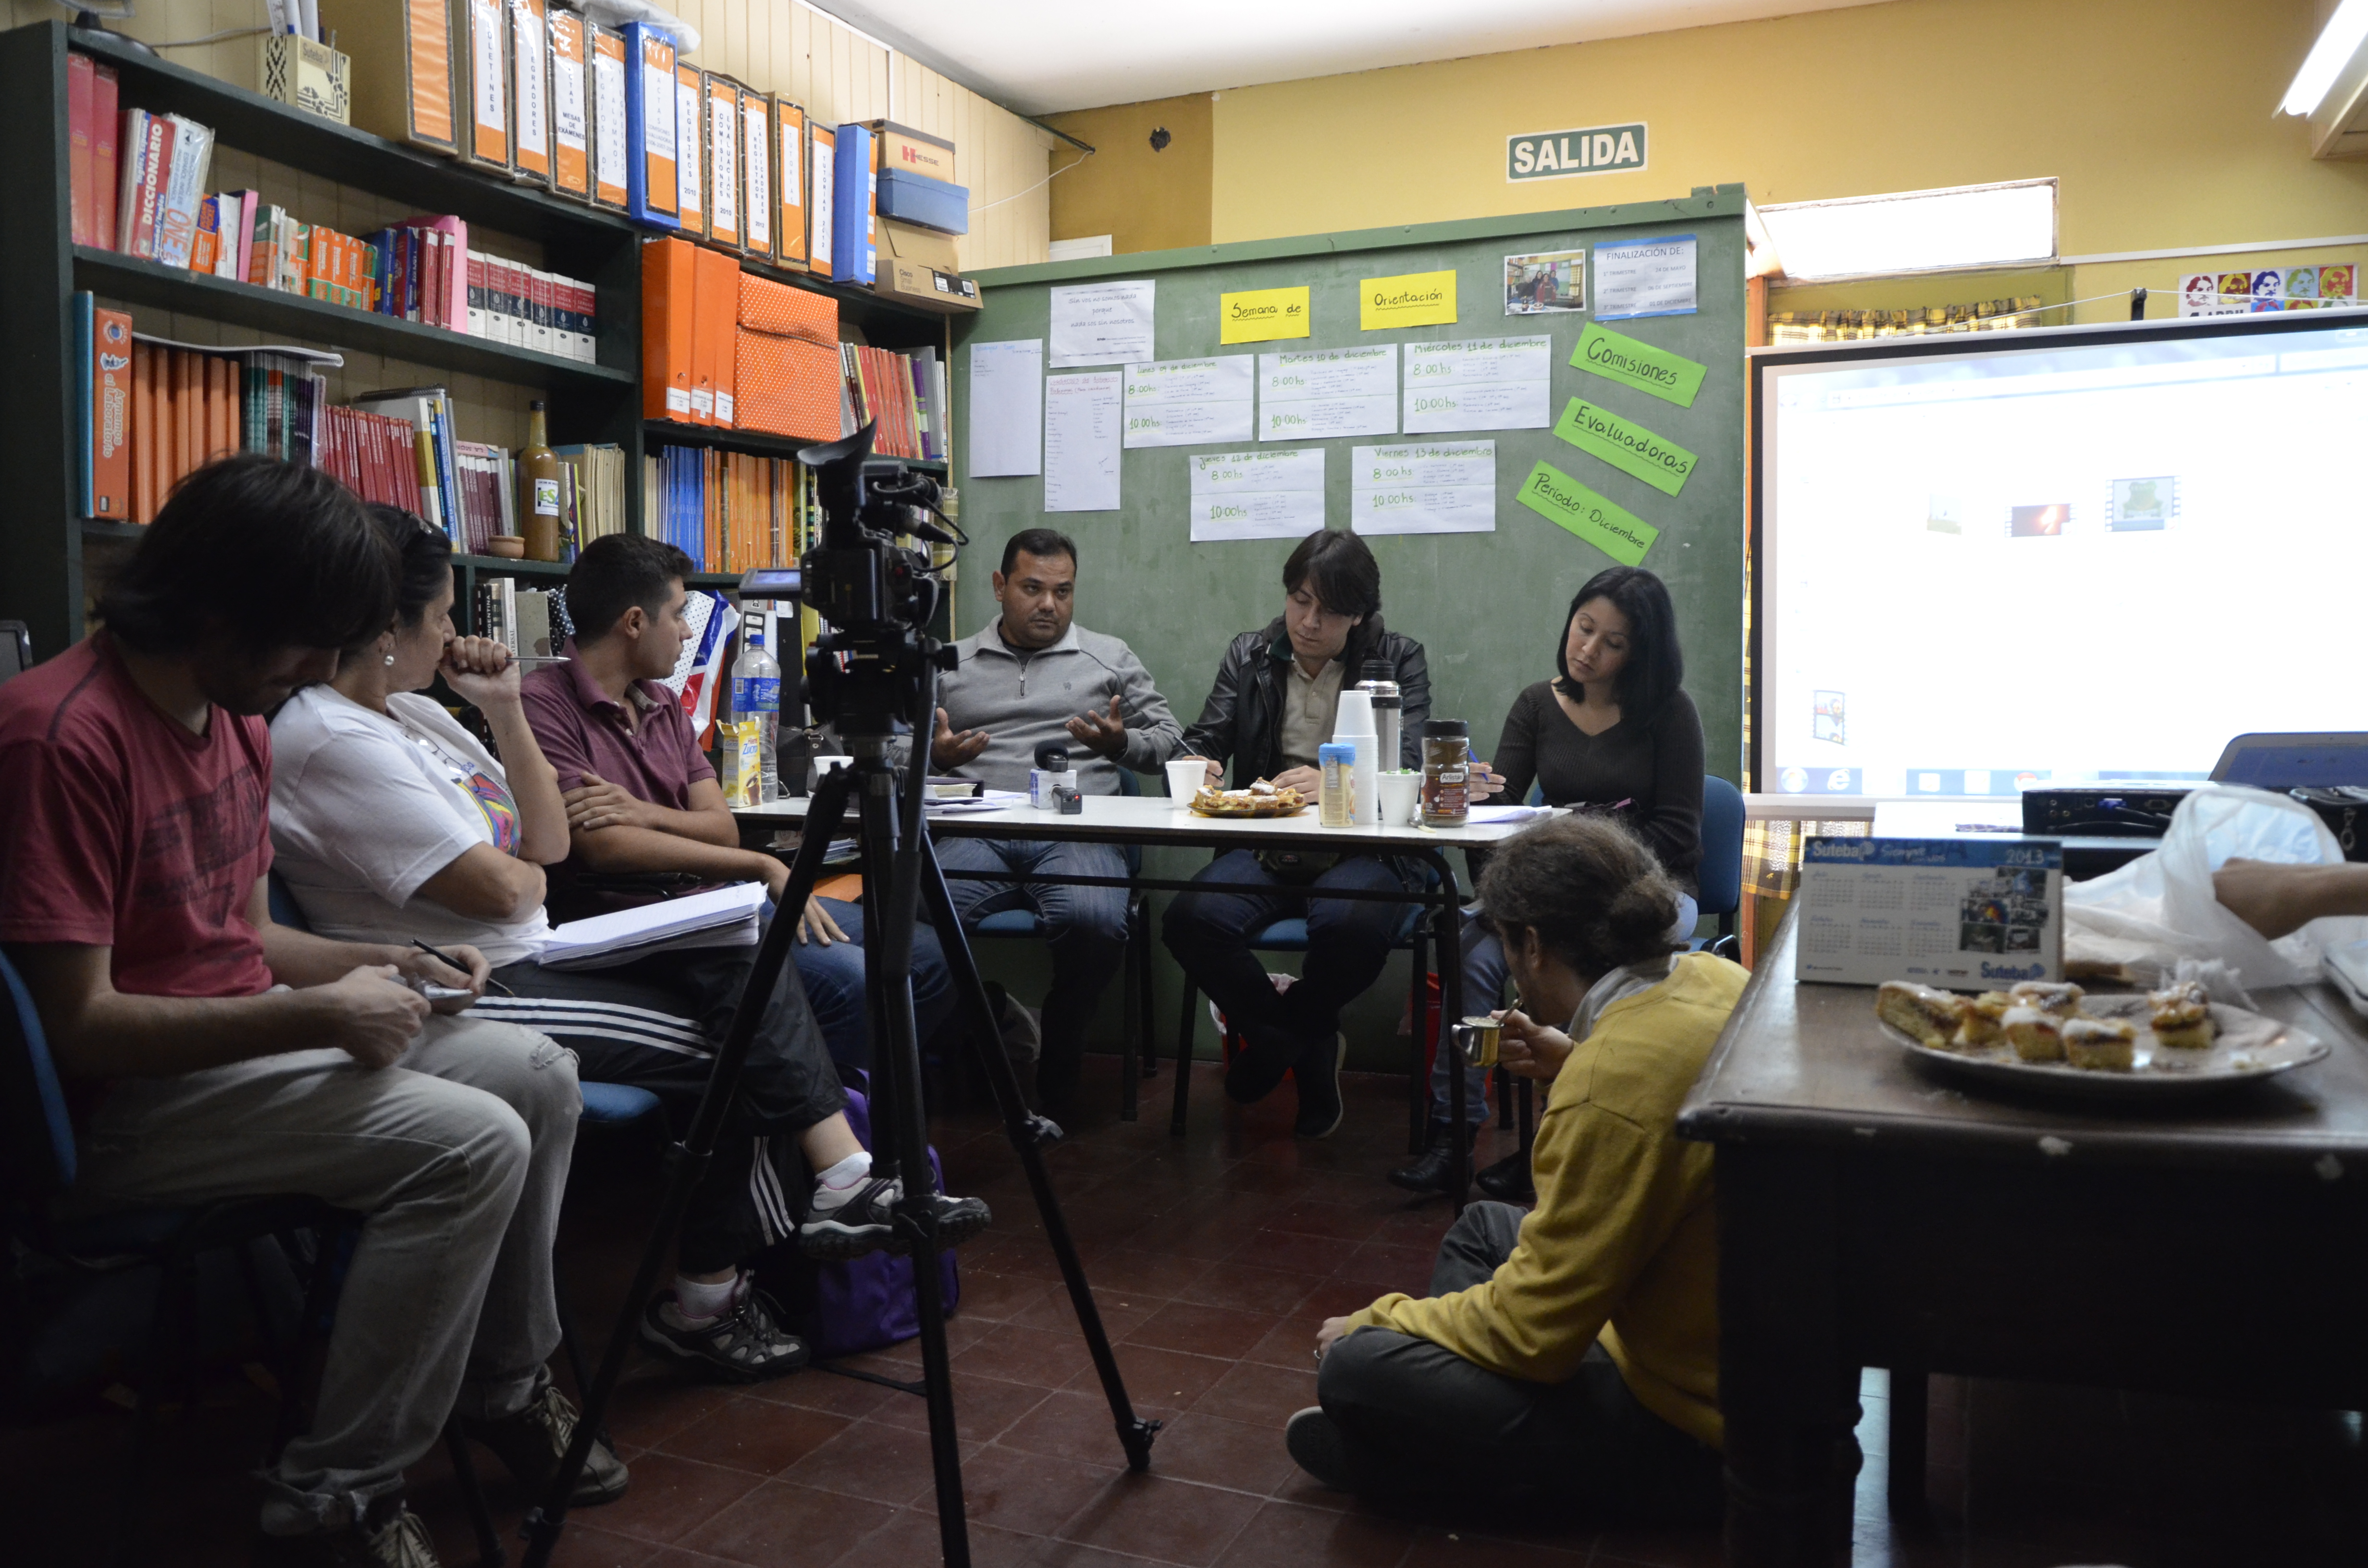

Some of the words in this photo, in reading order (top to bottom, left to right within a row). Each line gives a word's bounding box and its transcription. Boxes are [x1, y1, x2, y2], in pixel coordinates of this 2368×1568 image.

[563, 111, 580, 122] MESAS
[1514, 131, 1639, 173] SALIDA
[142, 123, 163, 226] DICCIONARIO
[684, 187, 696, 196] 2010
[720, 208, 732, 216] 2010
[1607, 247, 1667, 260] FINALIZACIÓN
[1669, 246, 1684, 255] DE:
[899, 269, 913, 278] Cisco
[1374, 288, 1443, 306] Orientación
[1092, 307, 1112, 315] porque
[1231, 303, 1278, 318] Semana
[1286, 303, 1302, 314] de
[1414, 342, 1463, 354] Miércoles
[1480, 342, 1493, 350] de
[1499, 339, 1547, 349] diciembre
[1279, 354, 1314, 365] Martes
[1317, 354, 1326, 362] 10
[1329, 352, 1340, 360] de
[1345, 349, 1387, 359] diciembre
[1587, 337, 1677, 385] Comisiones
[1137, 365, 1156, 374] Lunes
[1181, 361, 1217, 370] diciembre
[104, 373, 115, 388] el
[103, 388, 115, 458] Laboratorio
[113, 388, 126, 446] Armemos
[1574, 405, 1688, 474] Evaluadoras
[1257, 451, 1298, 460] diciembre
[1374, 447, 1409, 457] Viernes
[1416, 448, 1426, 458] 13
[1429, 448, 1440, 457] de
[1443, 446, 1493, 457] diciembre
[1589, 509, 1645, 549] Diciembre
[1813, 840, 1859, 858] Suteba
